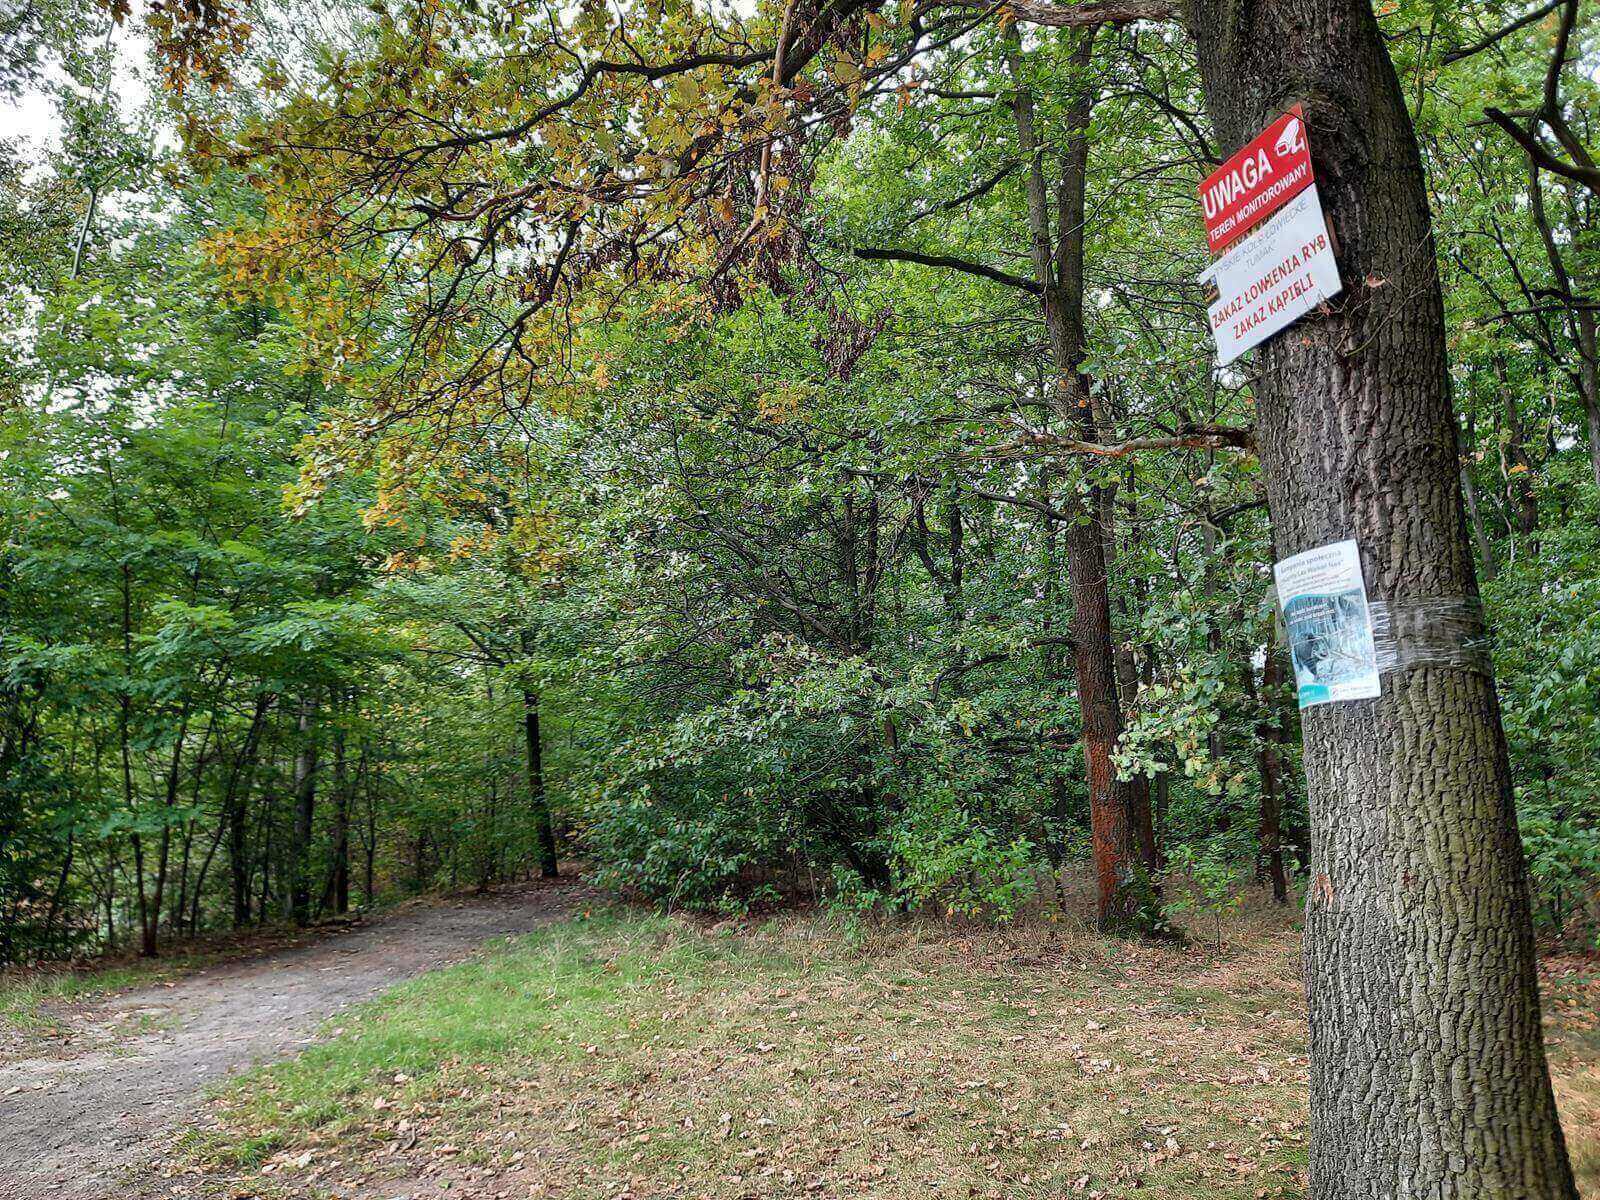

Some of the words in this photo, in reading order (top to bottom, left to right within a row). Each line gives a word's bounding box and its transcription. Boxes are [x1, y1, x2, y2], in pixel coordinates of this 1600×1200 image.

[1203, 148, 1273, 219] UWAGA
[1210, 215, 1236, 242] TEREN
[1236, 161, 1308, 224] MONITOROWANY
[1212, 295, 1244, 328] ZAKAZ
[1243, 254, 1301, 304] ŁOWIENIA
[1301, 234, 1326, 261] RYB
[1233, 306, 1267, 340] ZAKAZ
[1267, 272, 1314, 316] KĄPIELI
